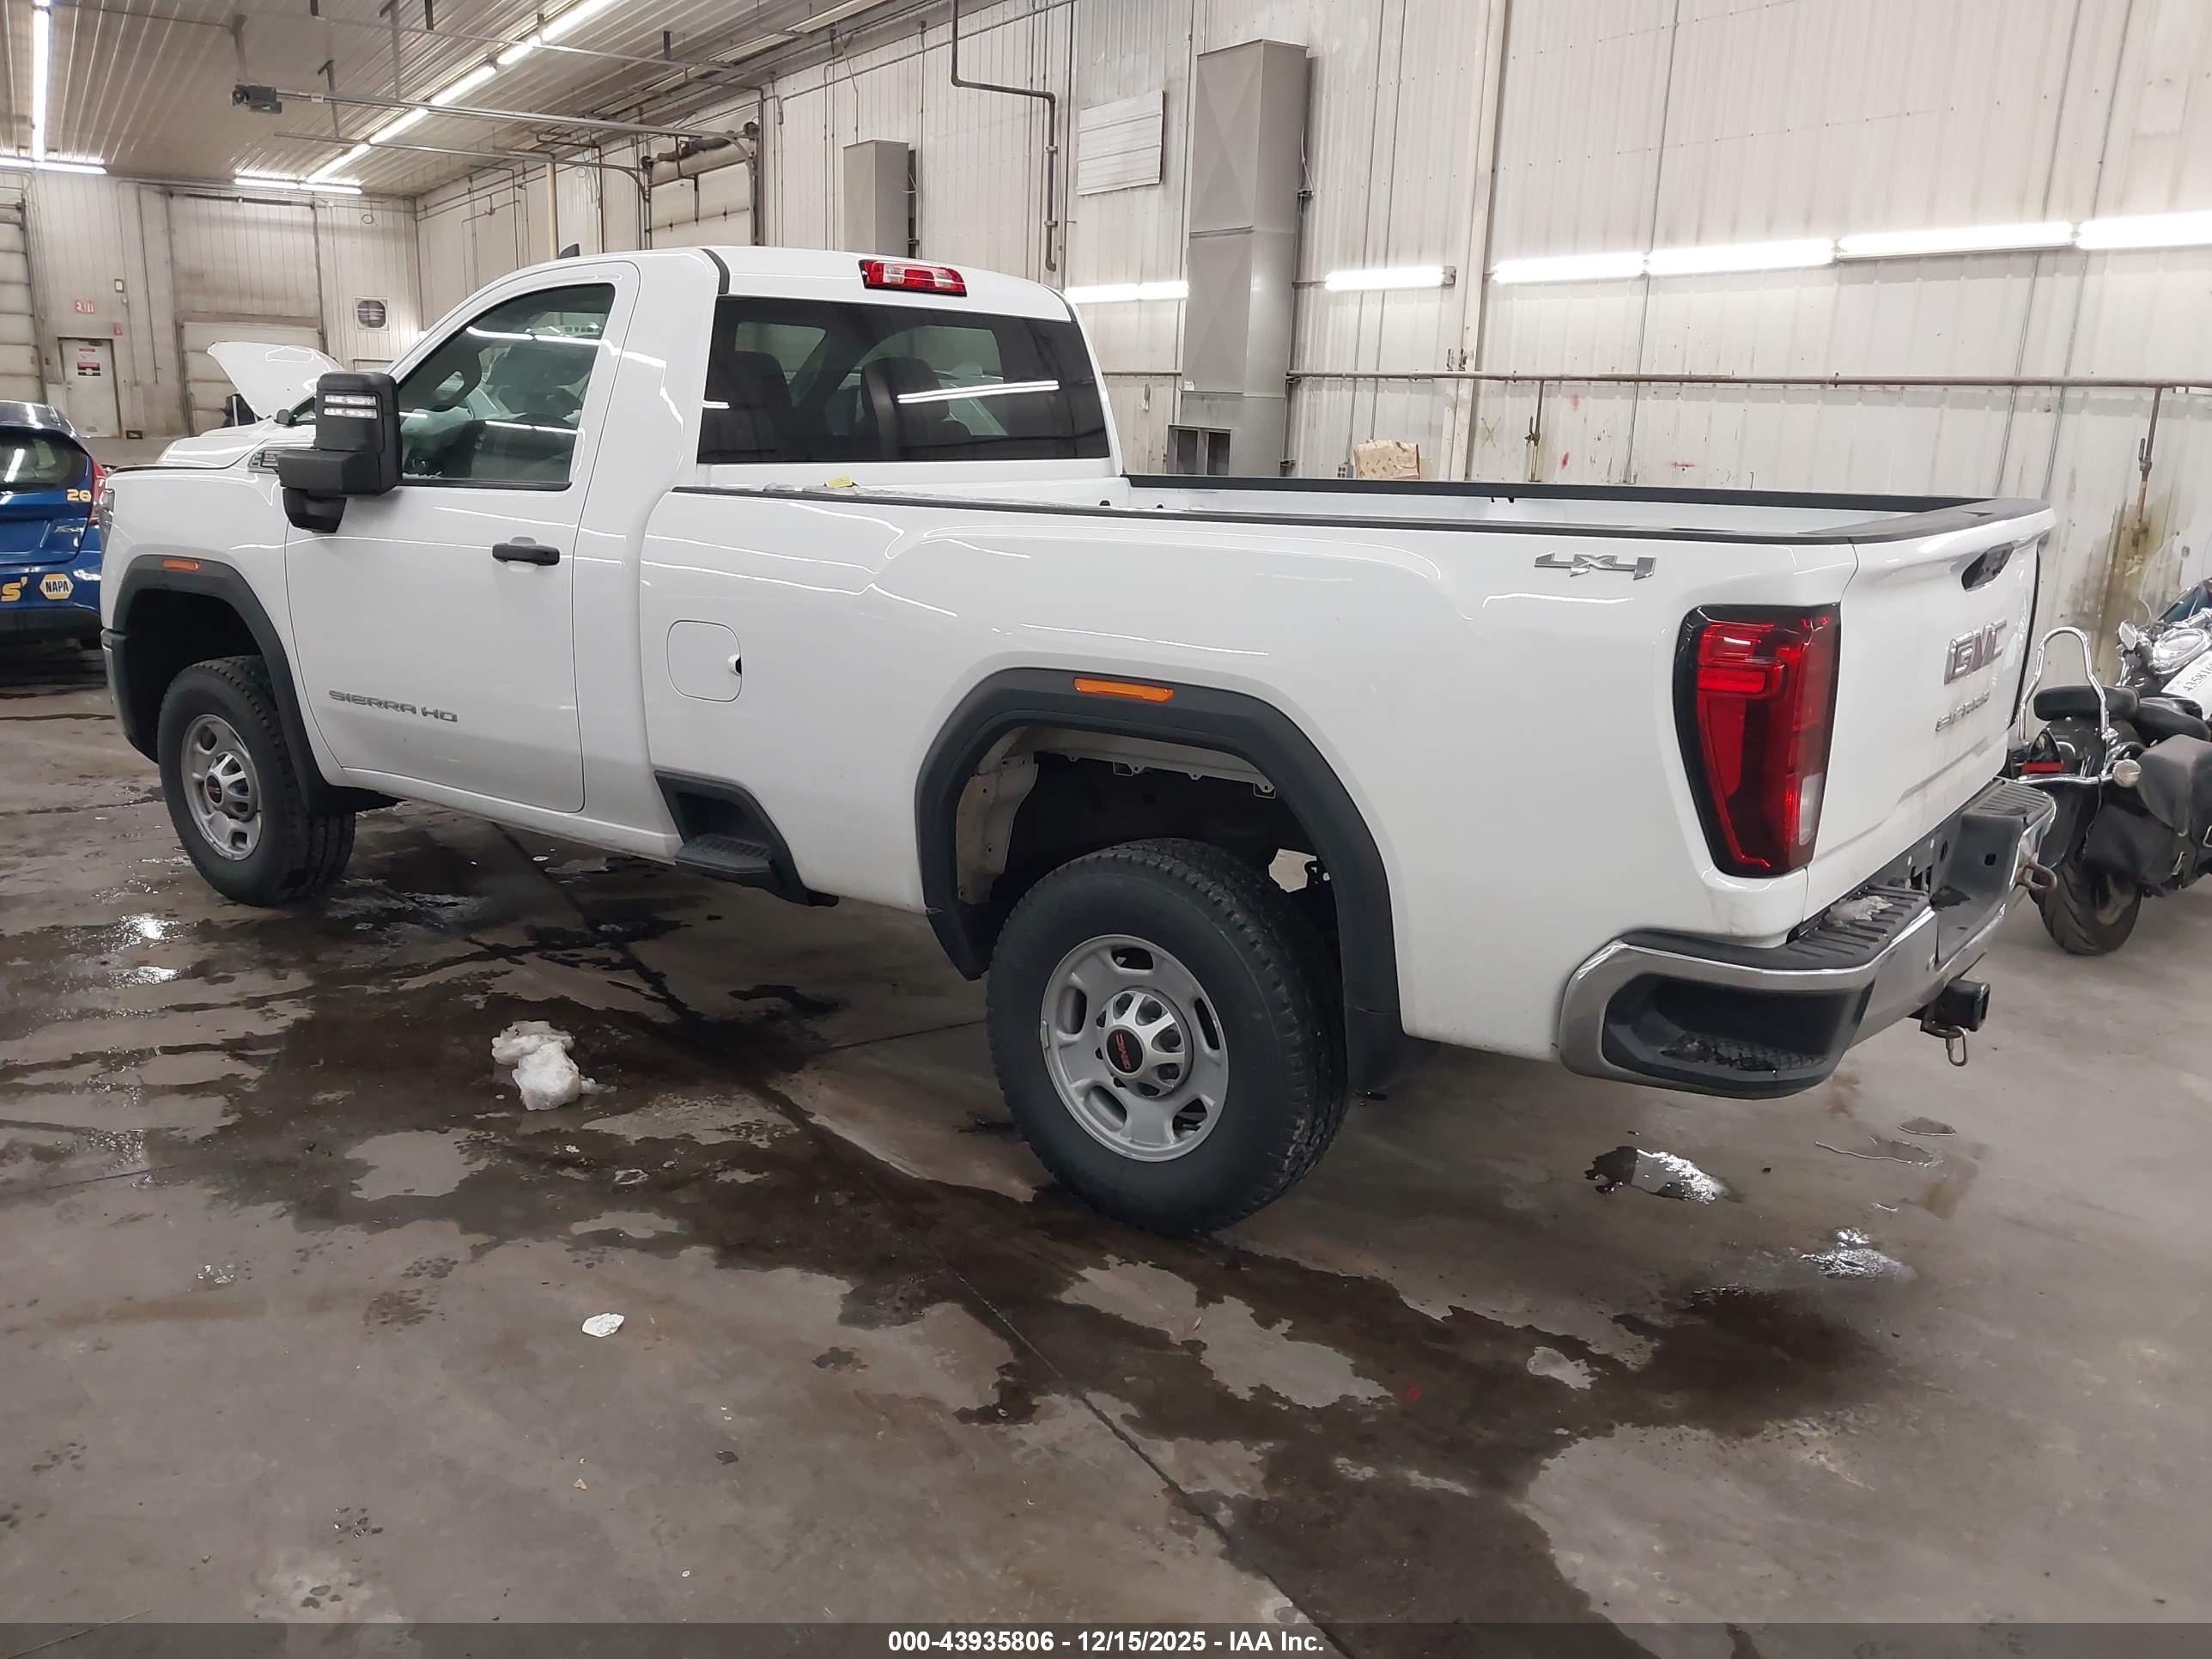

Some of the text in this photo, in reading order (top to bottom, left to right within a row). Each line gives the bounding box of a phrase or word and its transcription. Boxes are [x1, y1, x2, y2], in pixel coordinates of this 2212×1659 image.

[66, 489, 92, 501] 26
[45, 580, 70, 592] NAPA
[1944, 618, 2007, 685] GMC
[329, 690, 458, 722] SIERRA HD
